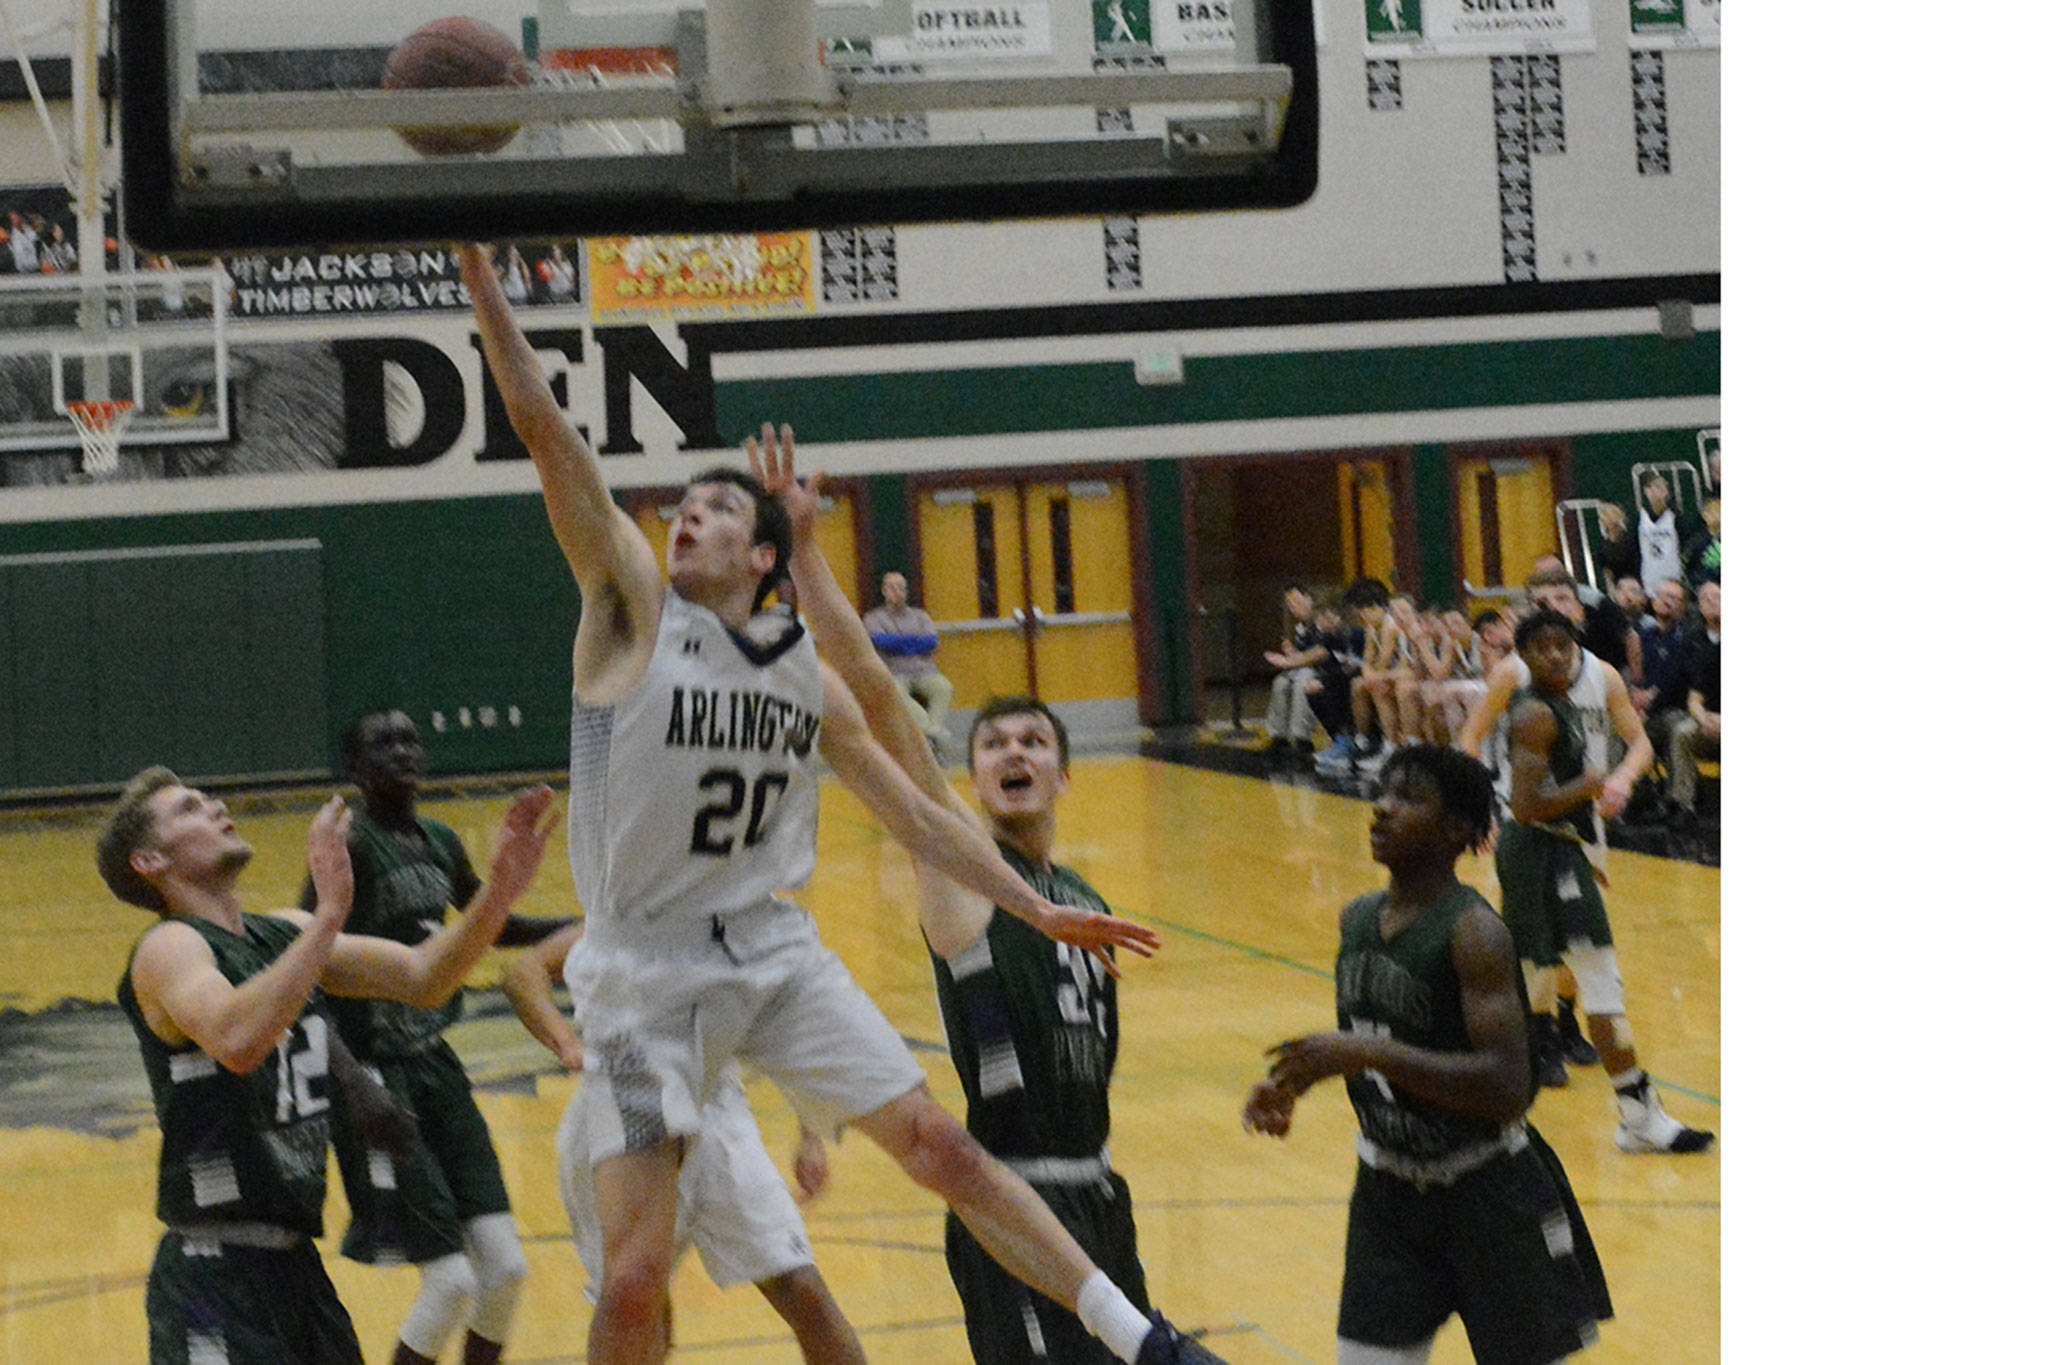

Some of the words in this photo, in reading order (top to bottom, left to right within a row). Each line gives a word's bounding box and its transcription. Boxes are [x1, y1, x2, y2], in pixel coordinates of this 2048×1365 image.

[917, 9, 1027, 30] OFTBALL
[1178, 3, 1229, 21] BAS
[271, 251, 446, 282] JACKSON
[333, 322, 724, 469] DEN
[689, 769, 790, 857] 20
[276, 1014, 330, 1123] 12
